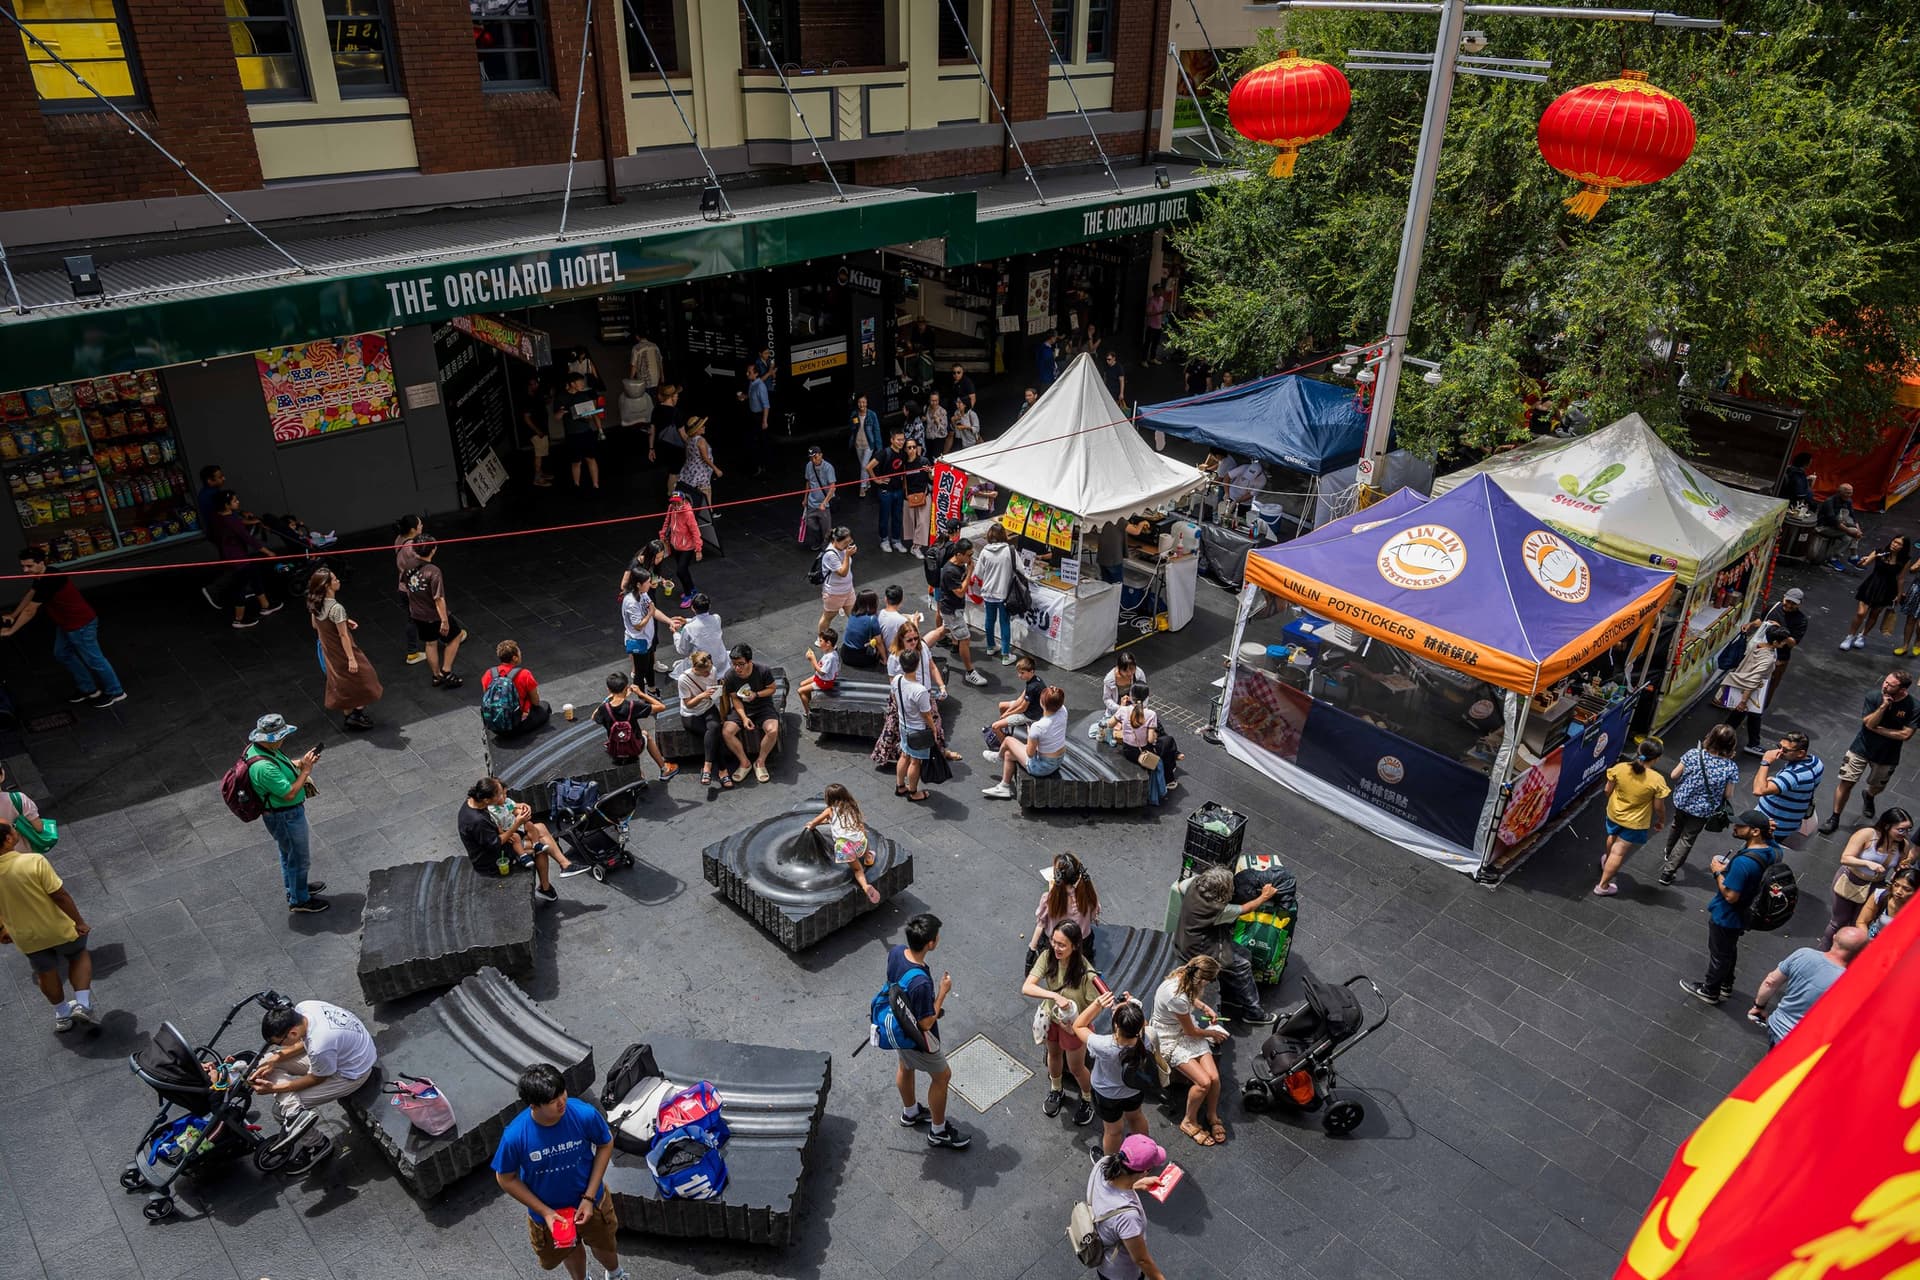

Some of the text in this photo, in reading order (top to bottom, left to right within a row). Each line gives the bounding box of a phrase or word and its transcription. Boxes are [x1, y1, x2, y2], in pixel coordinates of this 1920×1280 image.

[1083, 197, 1189, 236] THE ORCHARD HOTEL
[385, 251, 626, 317] THE ORCHARD HOTEL
[849, 269, 882, 295] King
[289, 359, 366, 392] Hello
[800, 362, 816, 371] OPEN
[275, 381, 393, 418] America
[1407, 527, 1462, 553] LIN LIN
[1526, 541, 1541, 560] LIN
[1540, 534, 1559, 547] LIN
[1381, 556, 1448, 586] POTSTICKERS
[1549, 566, 1588, 600] POTSTICKERS
[1283, 578, 1480, 667] LINLIN POTSTICKERS 林林锅贴
[1566, 645, 1590, 669] LINLIN
[1592, 614, 1636, 650] POTSTICKERS
